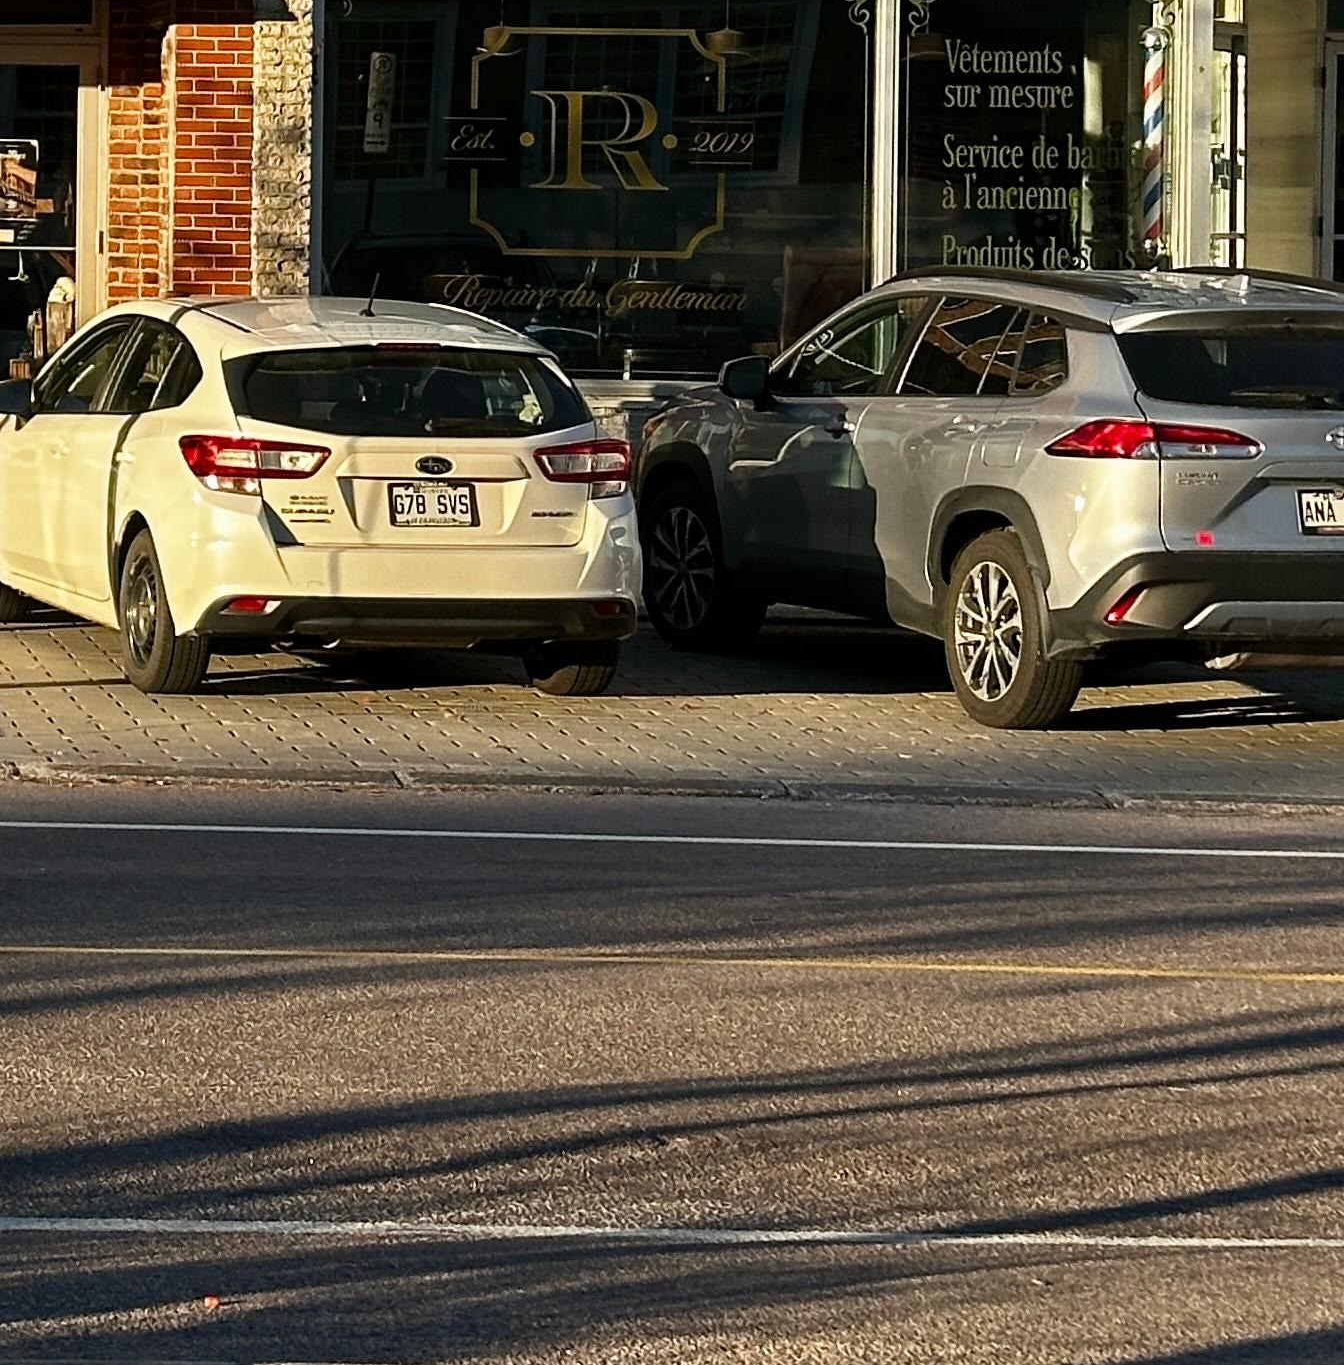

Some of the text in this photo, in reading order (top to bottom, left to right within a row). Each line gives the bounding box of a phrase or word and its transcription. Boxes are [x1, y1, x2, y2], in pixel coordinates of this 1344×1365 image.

[945, 38, 1063, 74] Vêtements
[943, 84, 1074, 108] sur mesure
[450, 124, 496, 151] Est.
[529, 90, 669, 191] R
[688, 131, 754, 154] 2019
[942, 133, 1024, 169] Service
[1032, 134, 1059, 170] de
[942, 177, 957, 209] à
[943, 235, 1034, 271] Produits
[1043, 236, 1070, 271] de
[606, 279, 749, 317] Gentleman
[437, 494, 469, 515] SVS
